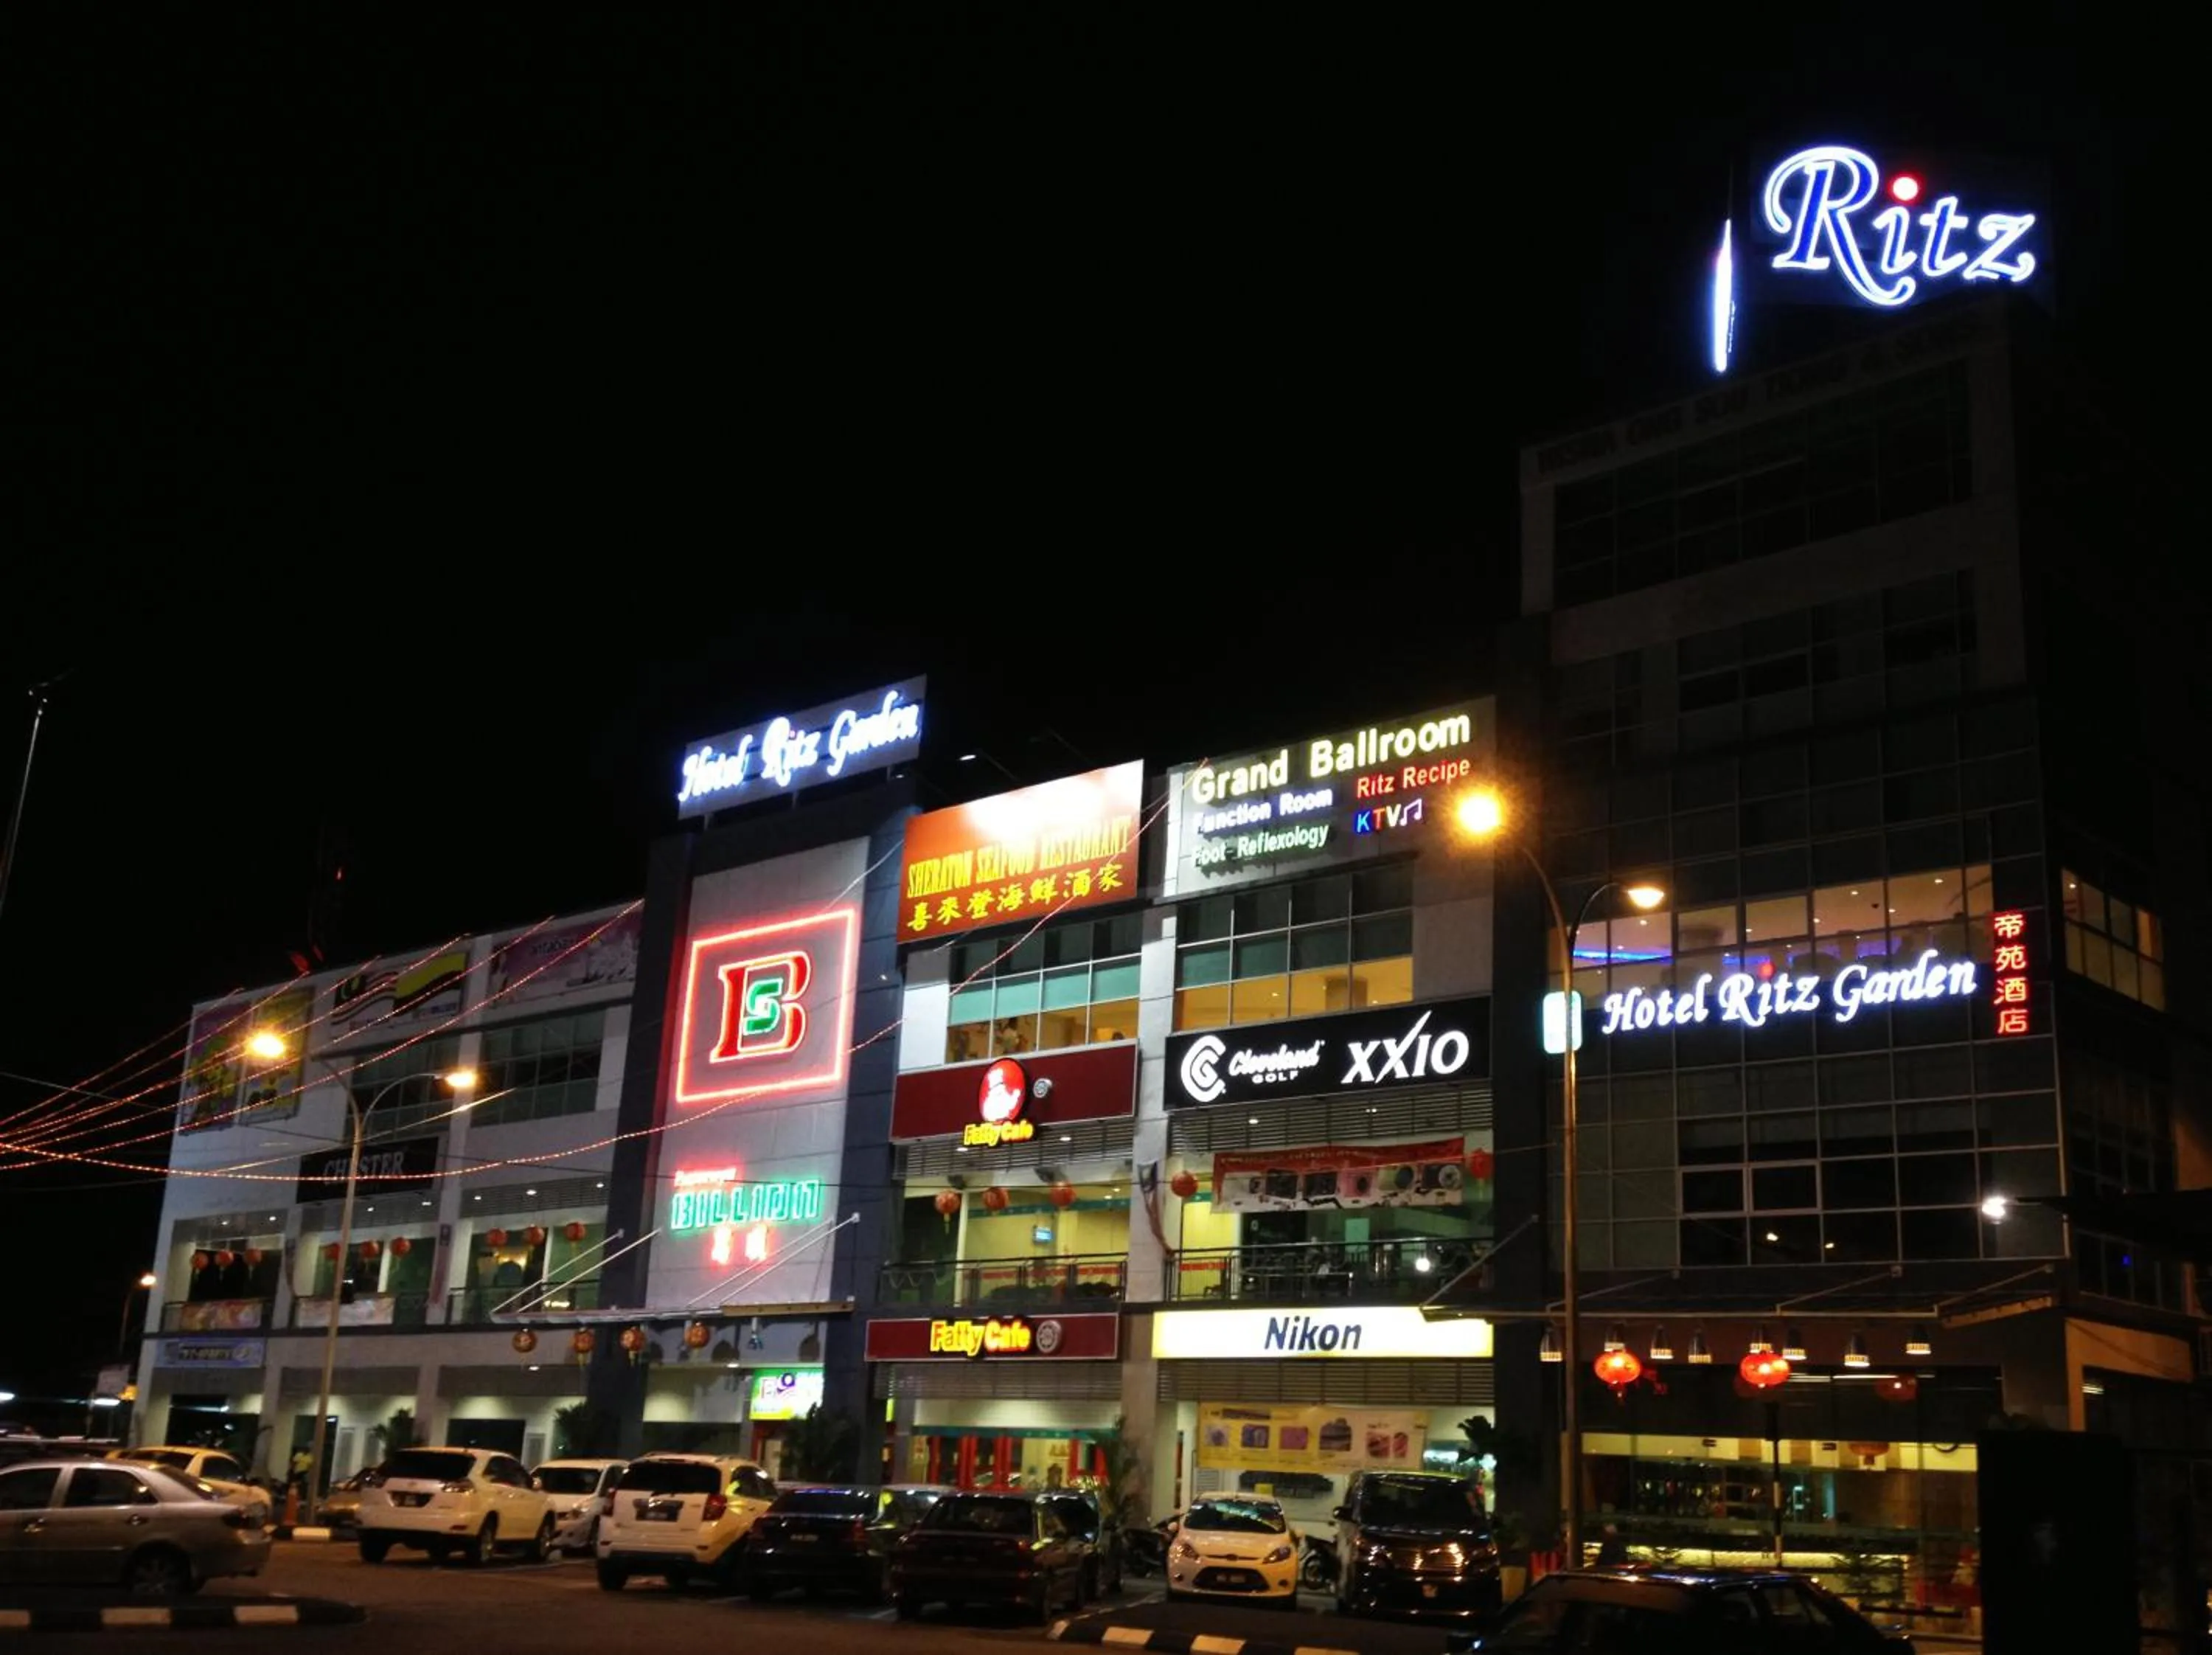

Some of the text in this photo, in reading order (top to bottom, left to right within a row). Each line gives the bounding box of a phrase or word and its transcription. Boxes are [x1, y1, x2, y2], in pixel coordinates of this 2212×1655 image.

[1764, 145, 2036, 305] Ritz
[678, 690, 919, 802] Hotel Ritz Garden
[1192, 714, 1470, 805] Grand Ballroom
[1357, 757, 1471, 799] Ritz Recipe
[1194, 790, 1333, 833] Function Room
[1357, 803, 1402, 833] KTV
[1237, 824, 1329, 858] Reflexology
[908, 850, 974, 898] SHERATON
[1601, 949, 1977, 1035] Hotel Ritz Garden
[1993, 913, 2028, 1035] 帝苑酒店
[1341, 1010, 1470, 1083] XXIO
[1251, 1070, 1298, 1084] GOLF
[963, 1118, 1034, 1147] Fatty Cafe
[930, 1319, 1031, 1357] Fatty Cafe
[1264, 1314, 1363, 1350] Nikon
